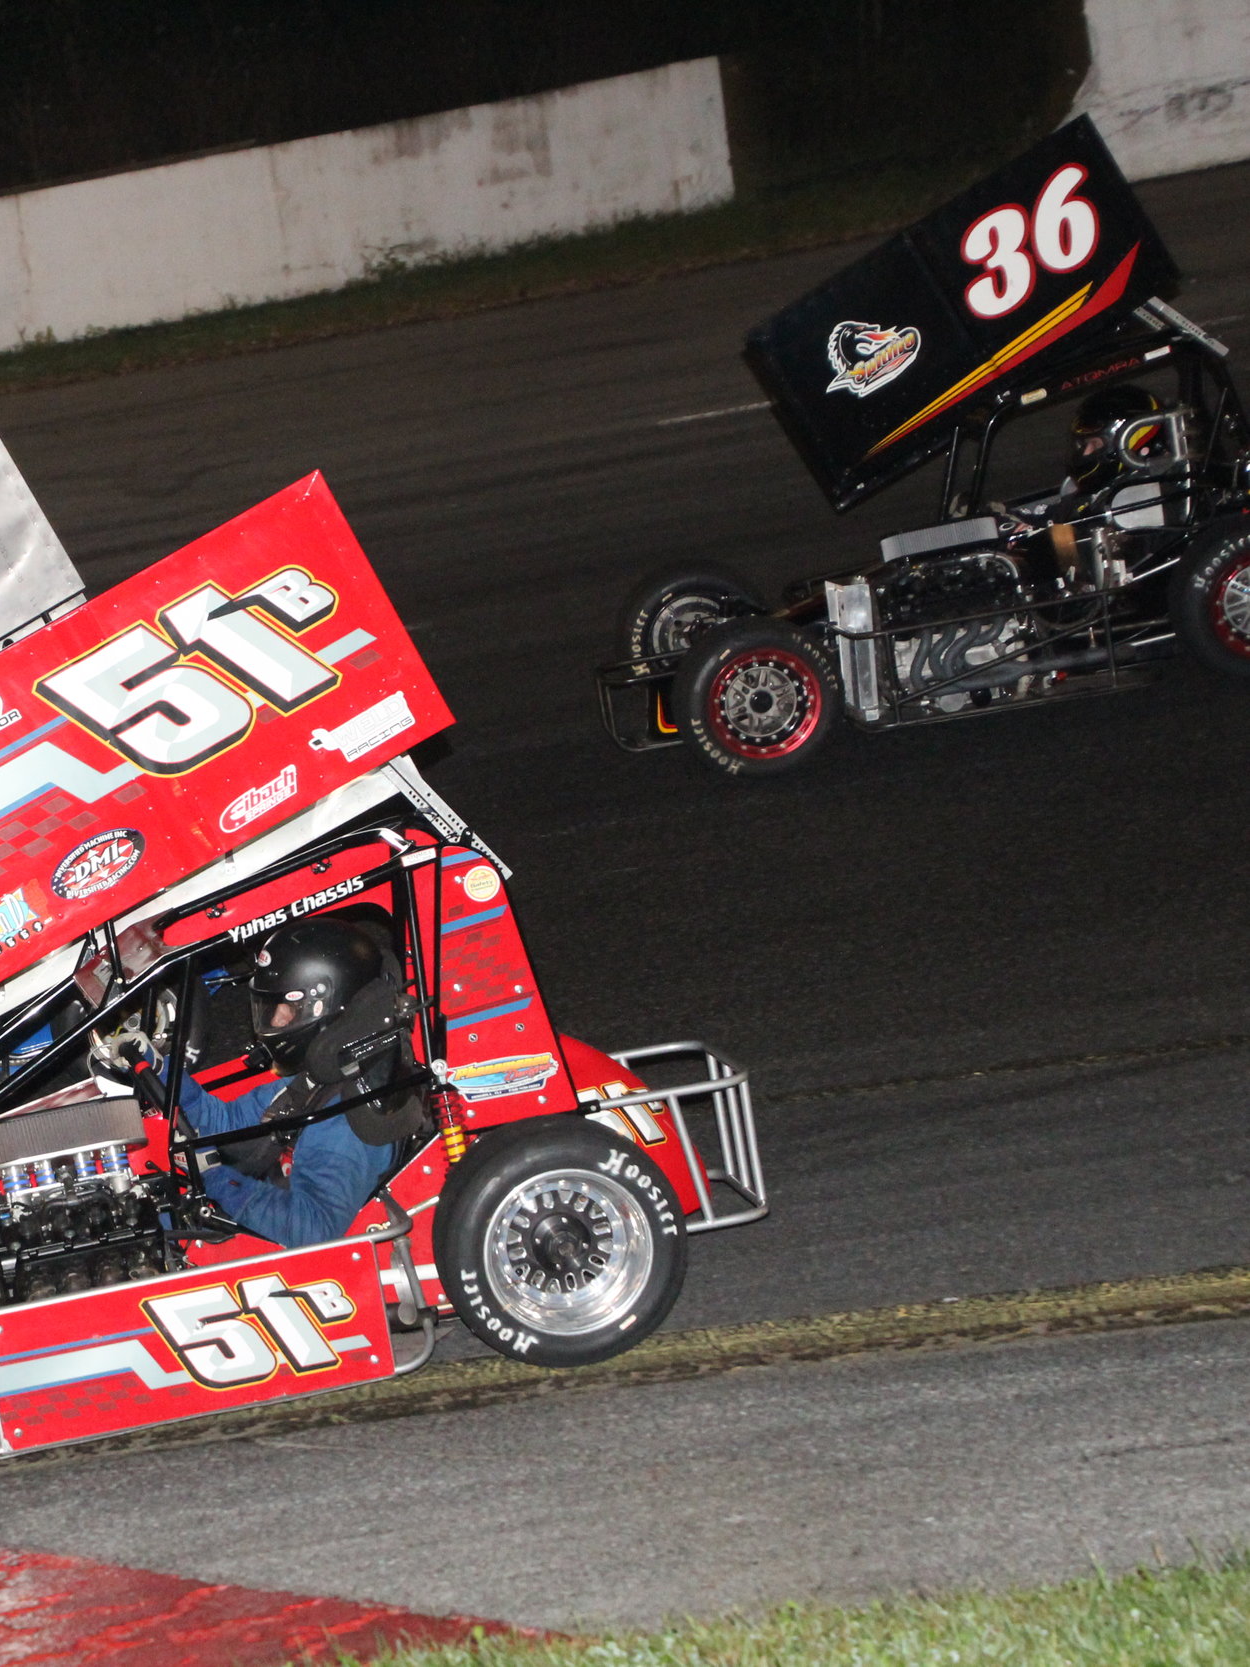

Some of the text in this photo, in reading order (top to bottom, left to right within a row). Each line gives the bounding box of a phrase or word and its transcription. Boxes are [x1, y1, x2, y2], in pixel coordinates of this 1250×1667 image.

[959, 161, 1100, 320] 36
[332, 699, 405, 748] WELD
[346, 715, 414, 760] RACING
[690, 717, 745, 775] Hoosier
[54, 830, 128, 878] DIVERSIFIED MACHINE INC
[73, 838, 120, 883] DMI
[227, 875, 365, 944] Yuhas Chassis
[597, 1148, 679, 1237] Hoosier
[460, 1268, 540, 1355] Hoosier
